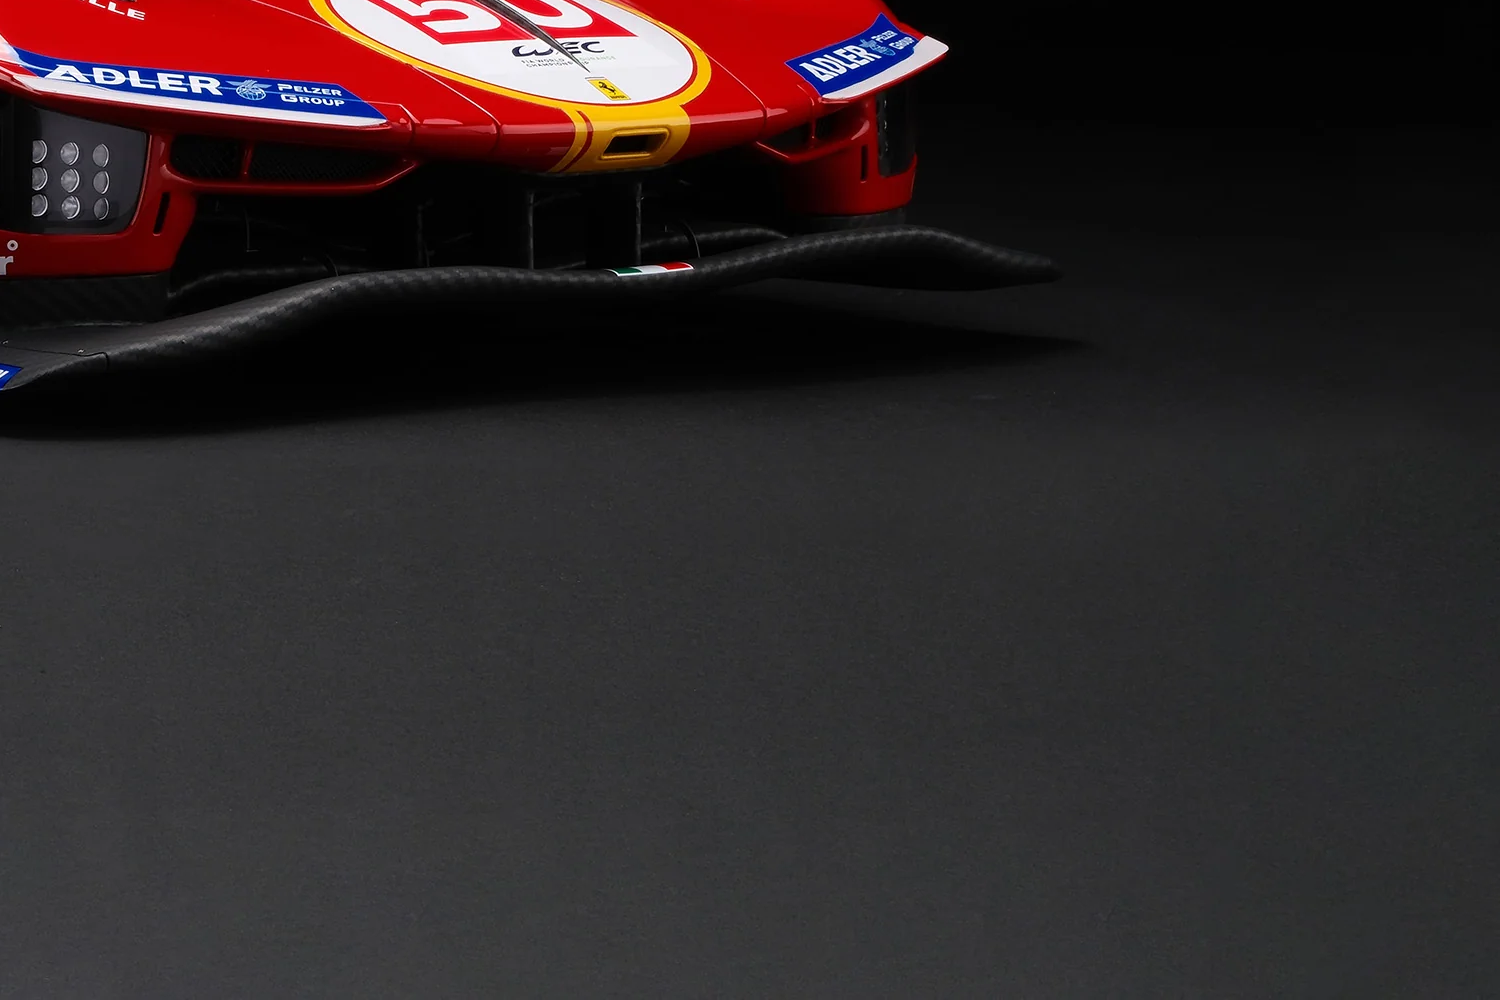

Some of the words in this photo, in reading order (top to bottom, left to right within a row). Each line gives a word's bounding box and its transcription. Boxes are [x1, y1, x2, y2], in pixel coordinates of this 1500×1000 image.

[799, 44, 882, 83] ADLER
[45, 63, 223, 97] ADLER
[277, 83, 343, 97] PELZER
[280, 94, 346, 108] GROUP
